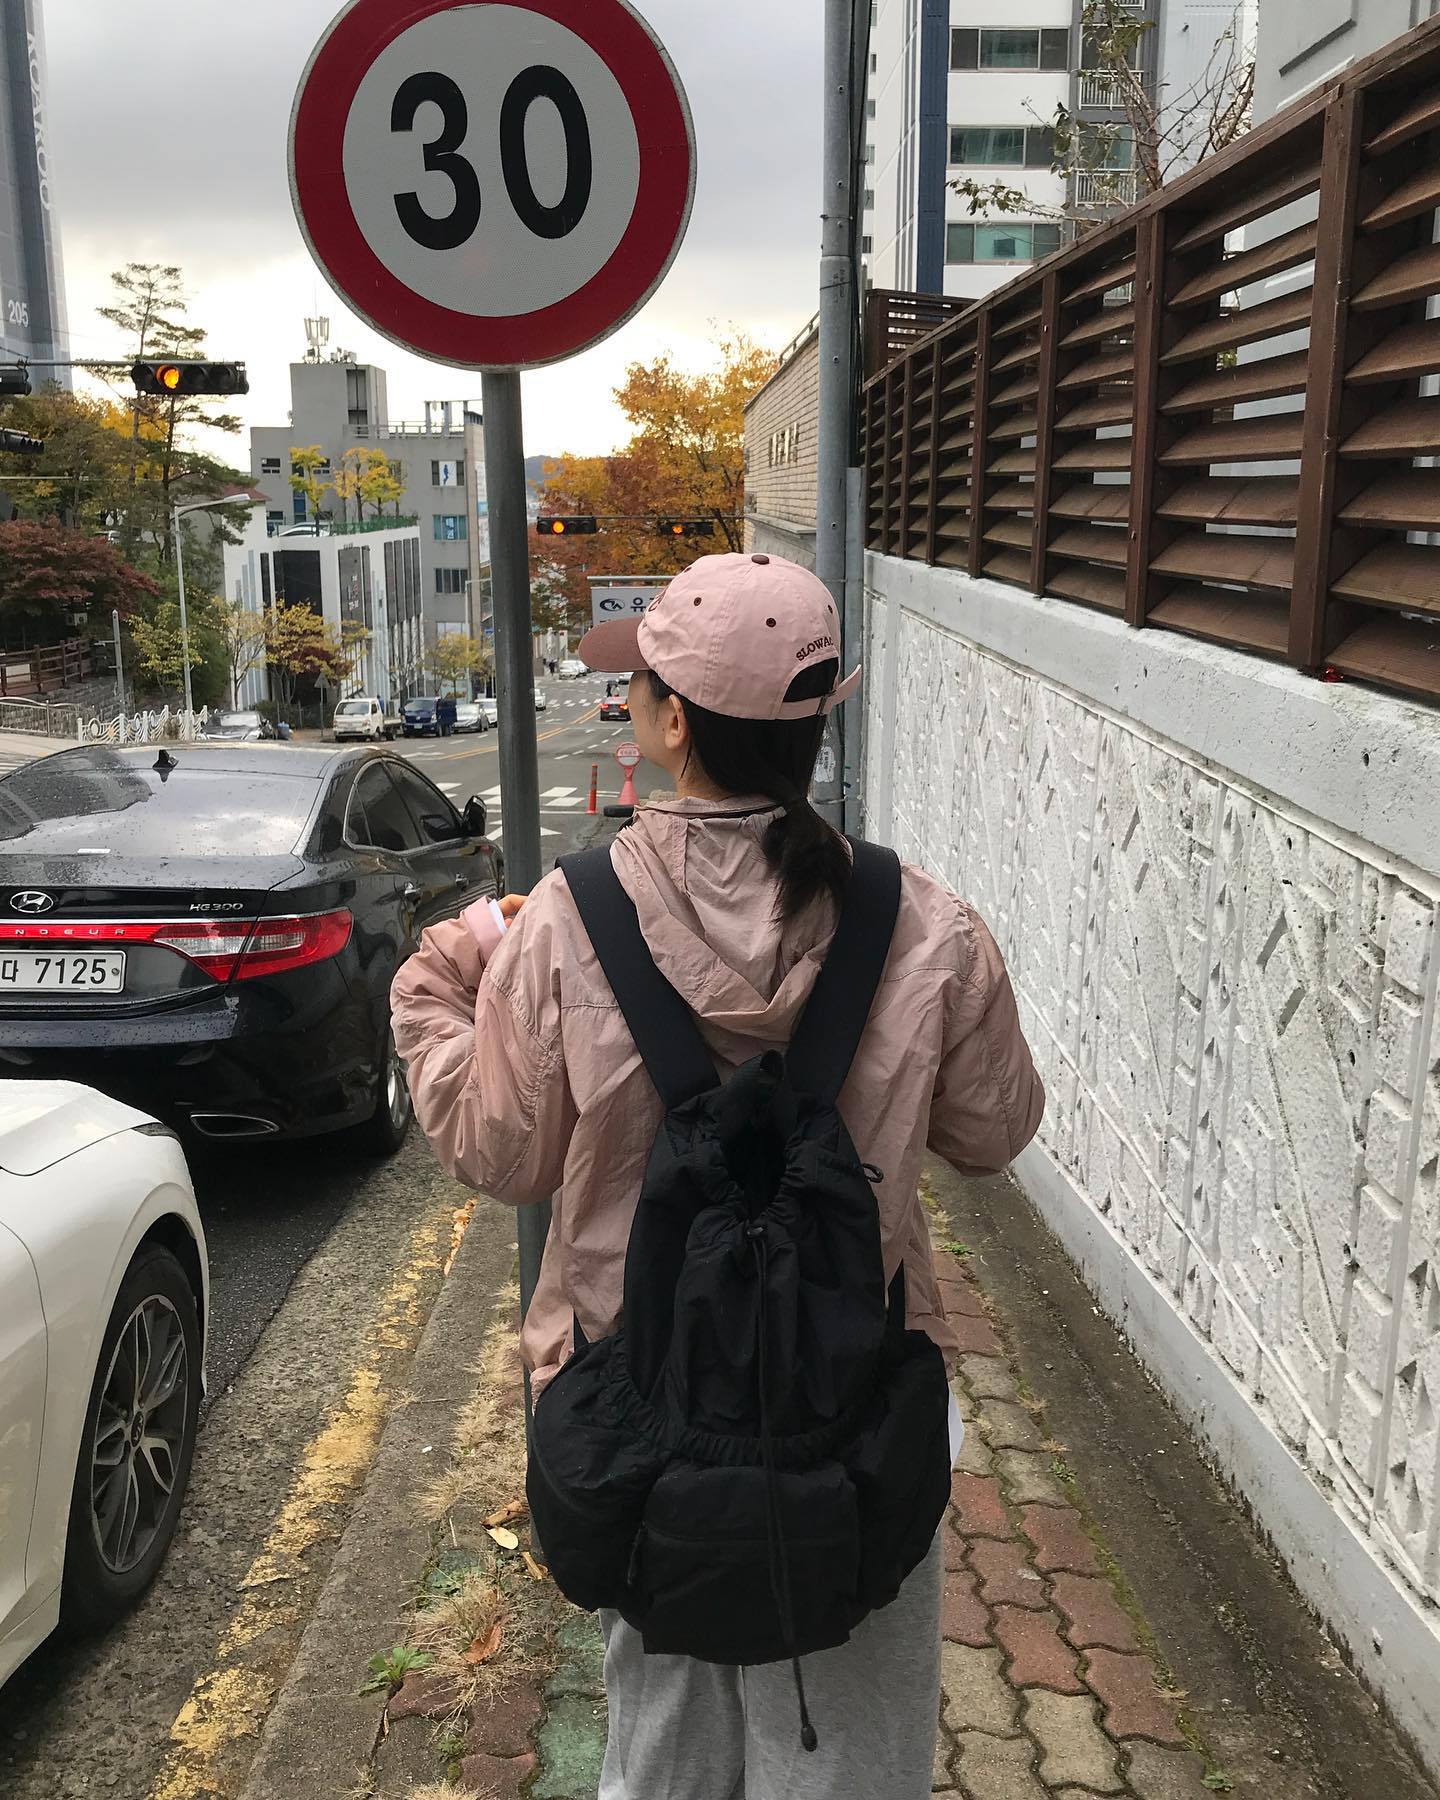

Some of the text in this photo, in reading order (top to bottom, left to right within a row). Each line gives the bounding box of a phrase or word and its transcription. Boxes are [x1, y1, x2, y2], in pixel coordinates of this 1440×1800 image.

[391, 65, 592, 250] 30
[8, 299, 28, 328] 205
[189, 903, 244, 911] HG300
[34, 957, 107, 985] 7125
